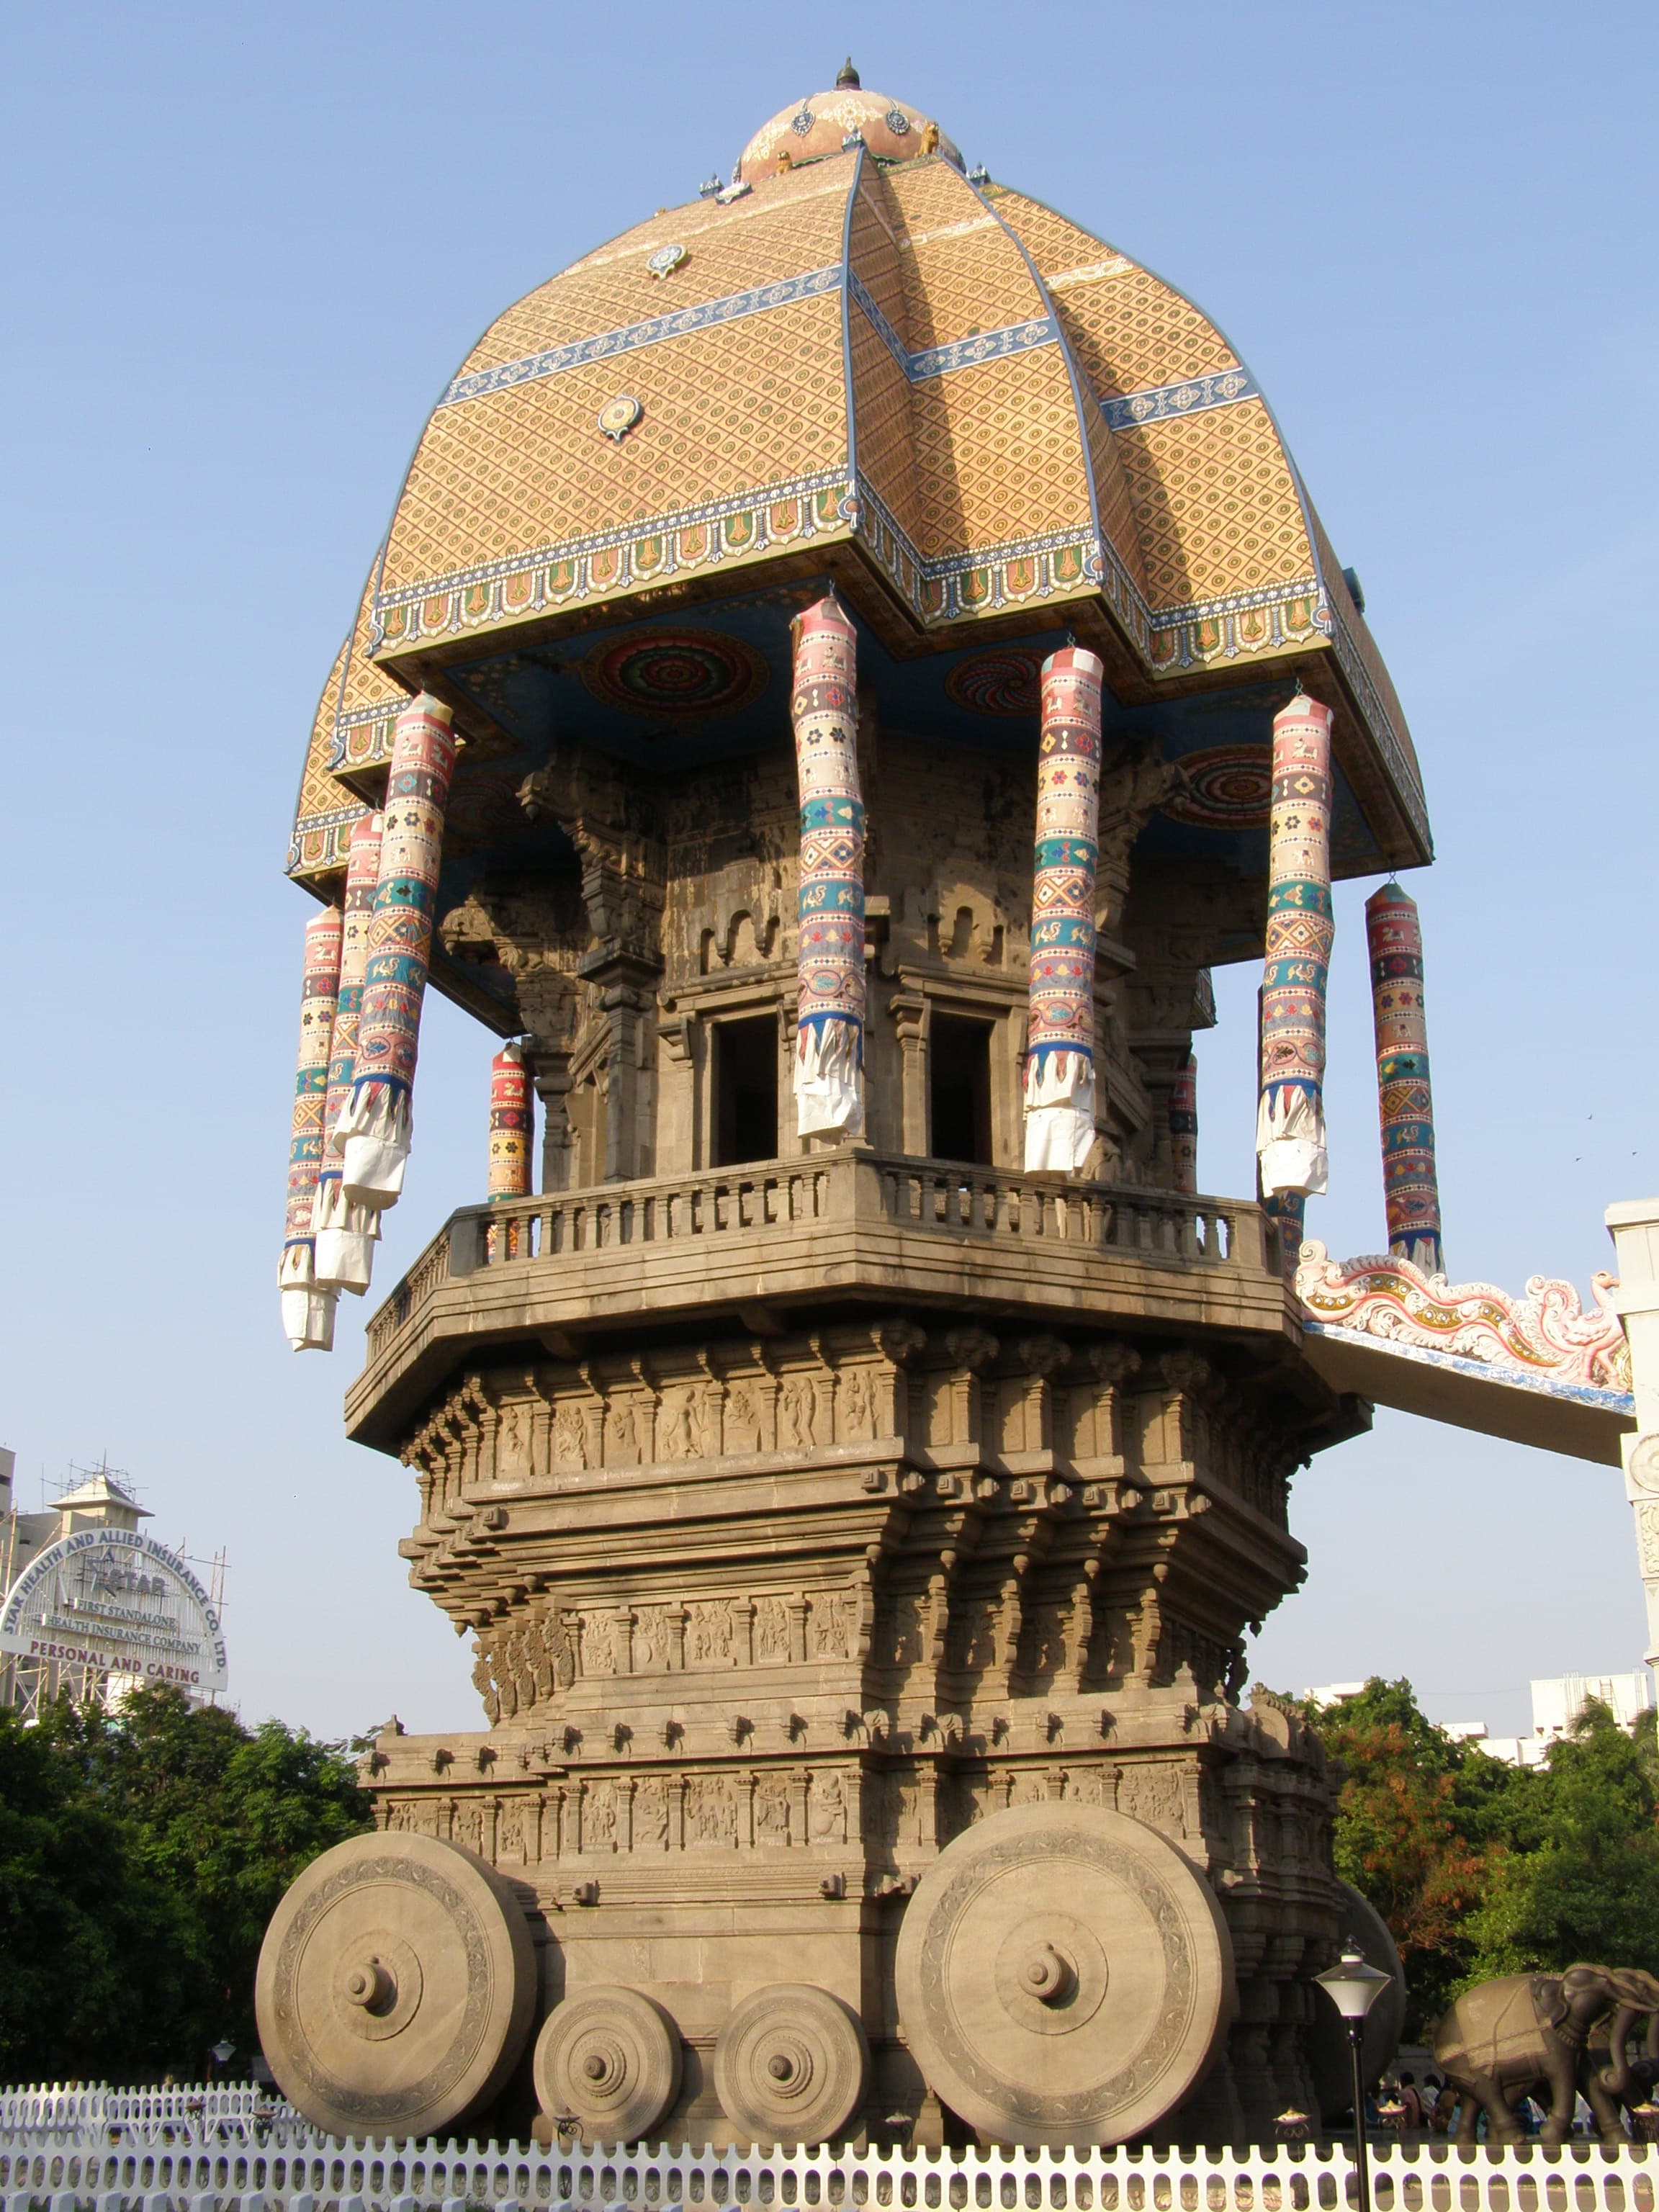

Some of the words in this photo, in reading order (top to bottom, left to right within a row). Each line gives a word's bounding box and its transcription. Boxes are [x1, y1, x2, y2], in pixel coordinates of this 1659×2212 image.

[4, 1596, 24, 1634] STAR
[20, 1547, 63, 1595] HEALTH
[67, 1533, 94, 1554] AND
[99, 1530, 143, 1548] ALLIED
[147, 1540, 209, 1607] INSURANCE
[204, 1609, 220, 1637] CO.
[214, 1640, 227, 1673] LTD.
[109, 1569, 166, 1598] STAR
[78, 1599, 107, 1615] FIRST
[109, 1606, 176, 1629] STANDALONE
[48, 1617, 89, 1633] HEALTH
[92, 1624, 151, 1644] INSURANCE
[153, 1635, 201, 1655] COMPANY
[30, 1640, 106, 1667] PERSONAL
[111, 1656, 142, 1672] AND
[146, 1663, 199, 1683] CARING
